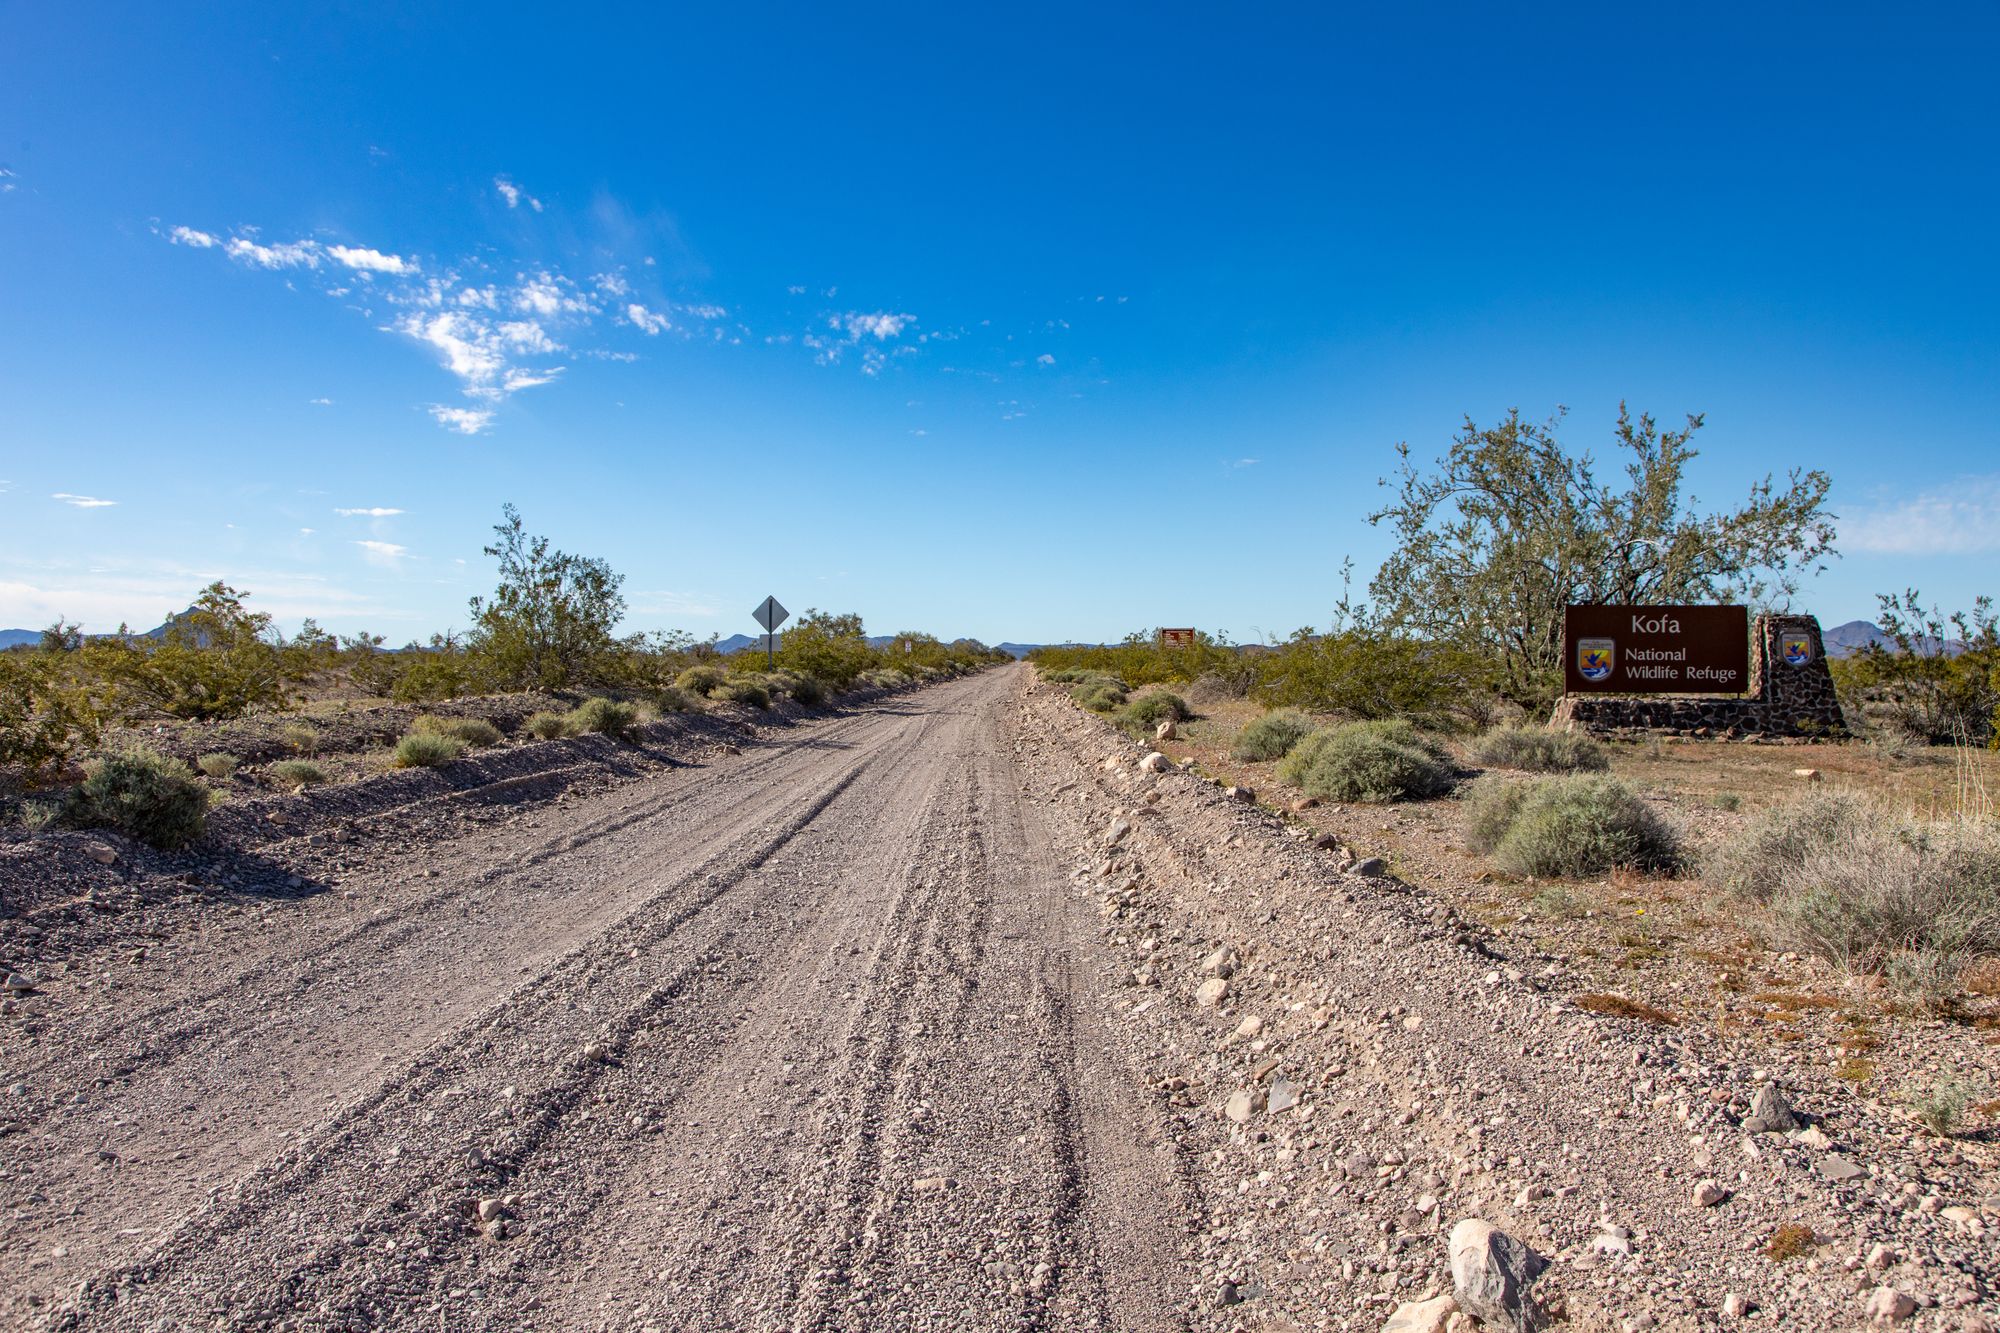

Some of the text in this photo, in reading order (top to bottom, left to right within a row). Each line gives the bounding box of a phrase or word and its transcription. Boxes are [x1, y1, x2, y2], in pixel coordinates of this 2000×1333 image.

[1632, 614, 1681, 634] Kofa
[1625, 647, 1686, 661] National
[1626, 666, 1737, 683] Wildlife Refuge
